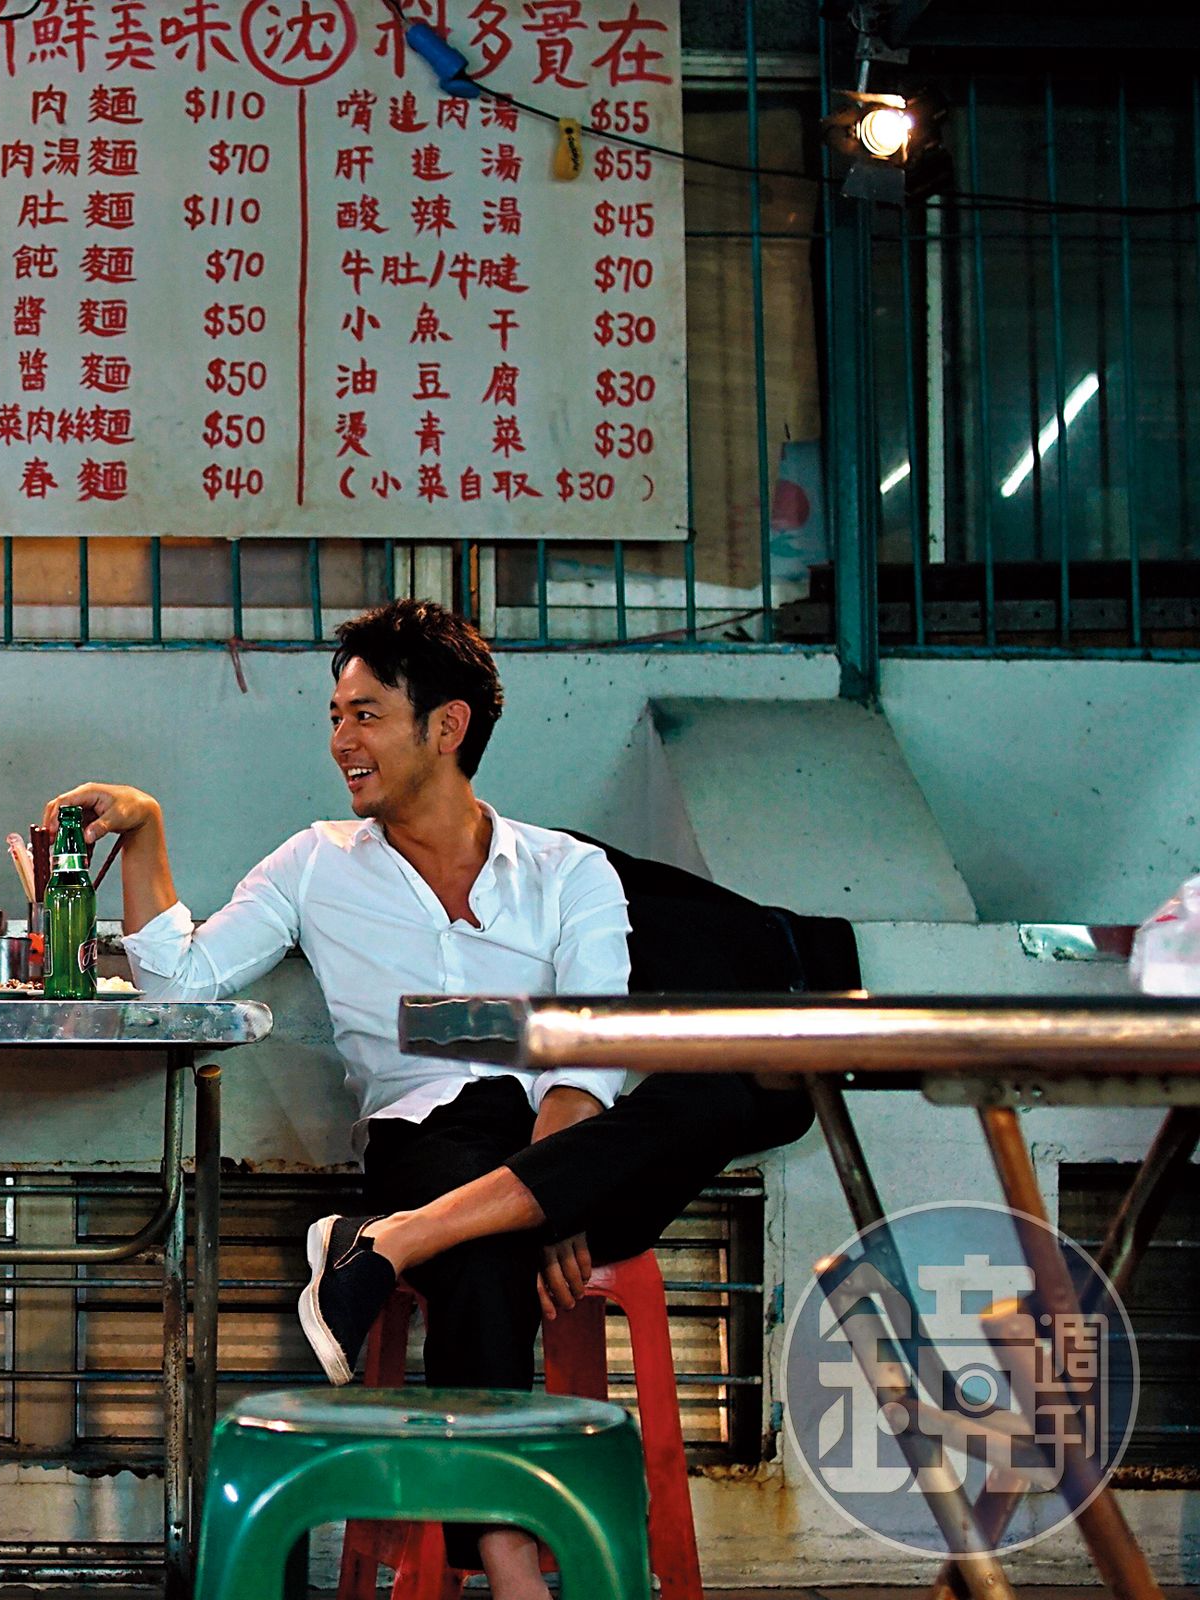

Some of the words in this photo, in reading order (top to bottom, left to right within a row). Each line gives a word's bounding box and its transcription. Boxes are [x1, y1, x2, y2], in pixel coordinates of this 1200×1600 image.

[263, 3, 337, 64] 沈
[185, 87, 266, 124] $110
[591, 99, 650, 134] $55
[208, 140, 271, 175] $70
[336, 143, 521, 182] 肝連湯
[593, 146, 653, 181] $55
[183, 194, 260, 229] $110
[335, 194, 521, 235] 酸辣湯
[593, 200, 656, 239] $45
[206, 249, 265, 283] $70
[594, 255, 653, 294] $70
[203, 303, 266, 338] $50
[343, 303, 518, 352] 小魚干
[594, 311, 657, 348] $30
[206, 358, 267, 398] $50
[335, 358, 519, 406] 油豆腐
[595, 369, 656, 408] $30
[203, 410, 265, 449] $50
[594, 422, 654, 459] $30
[203, 464, 263, 501] $40
